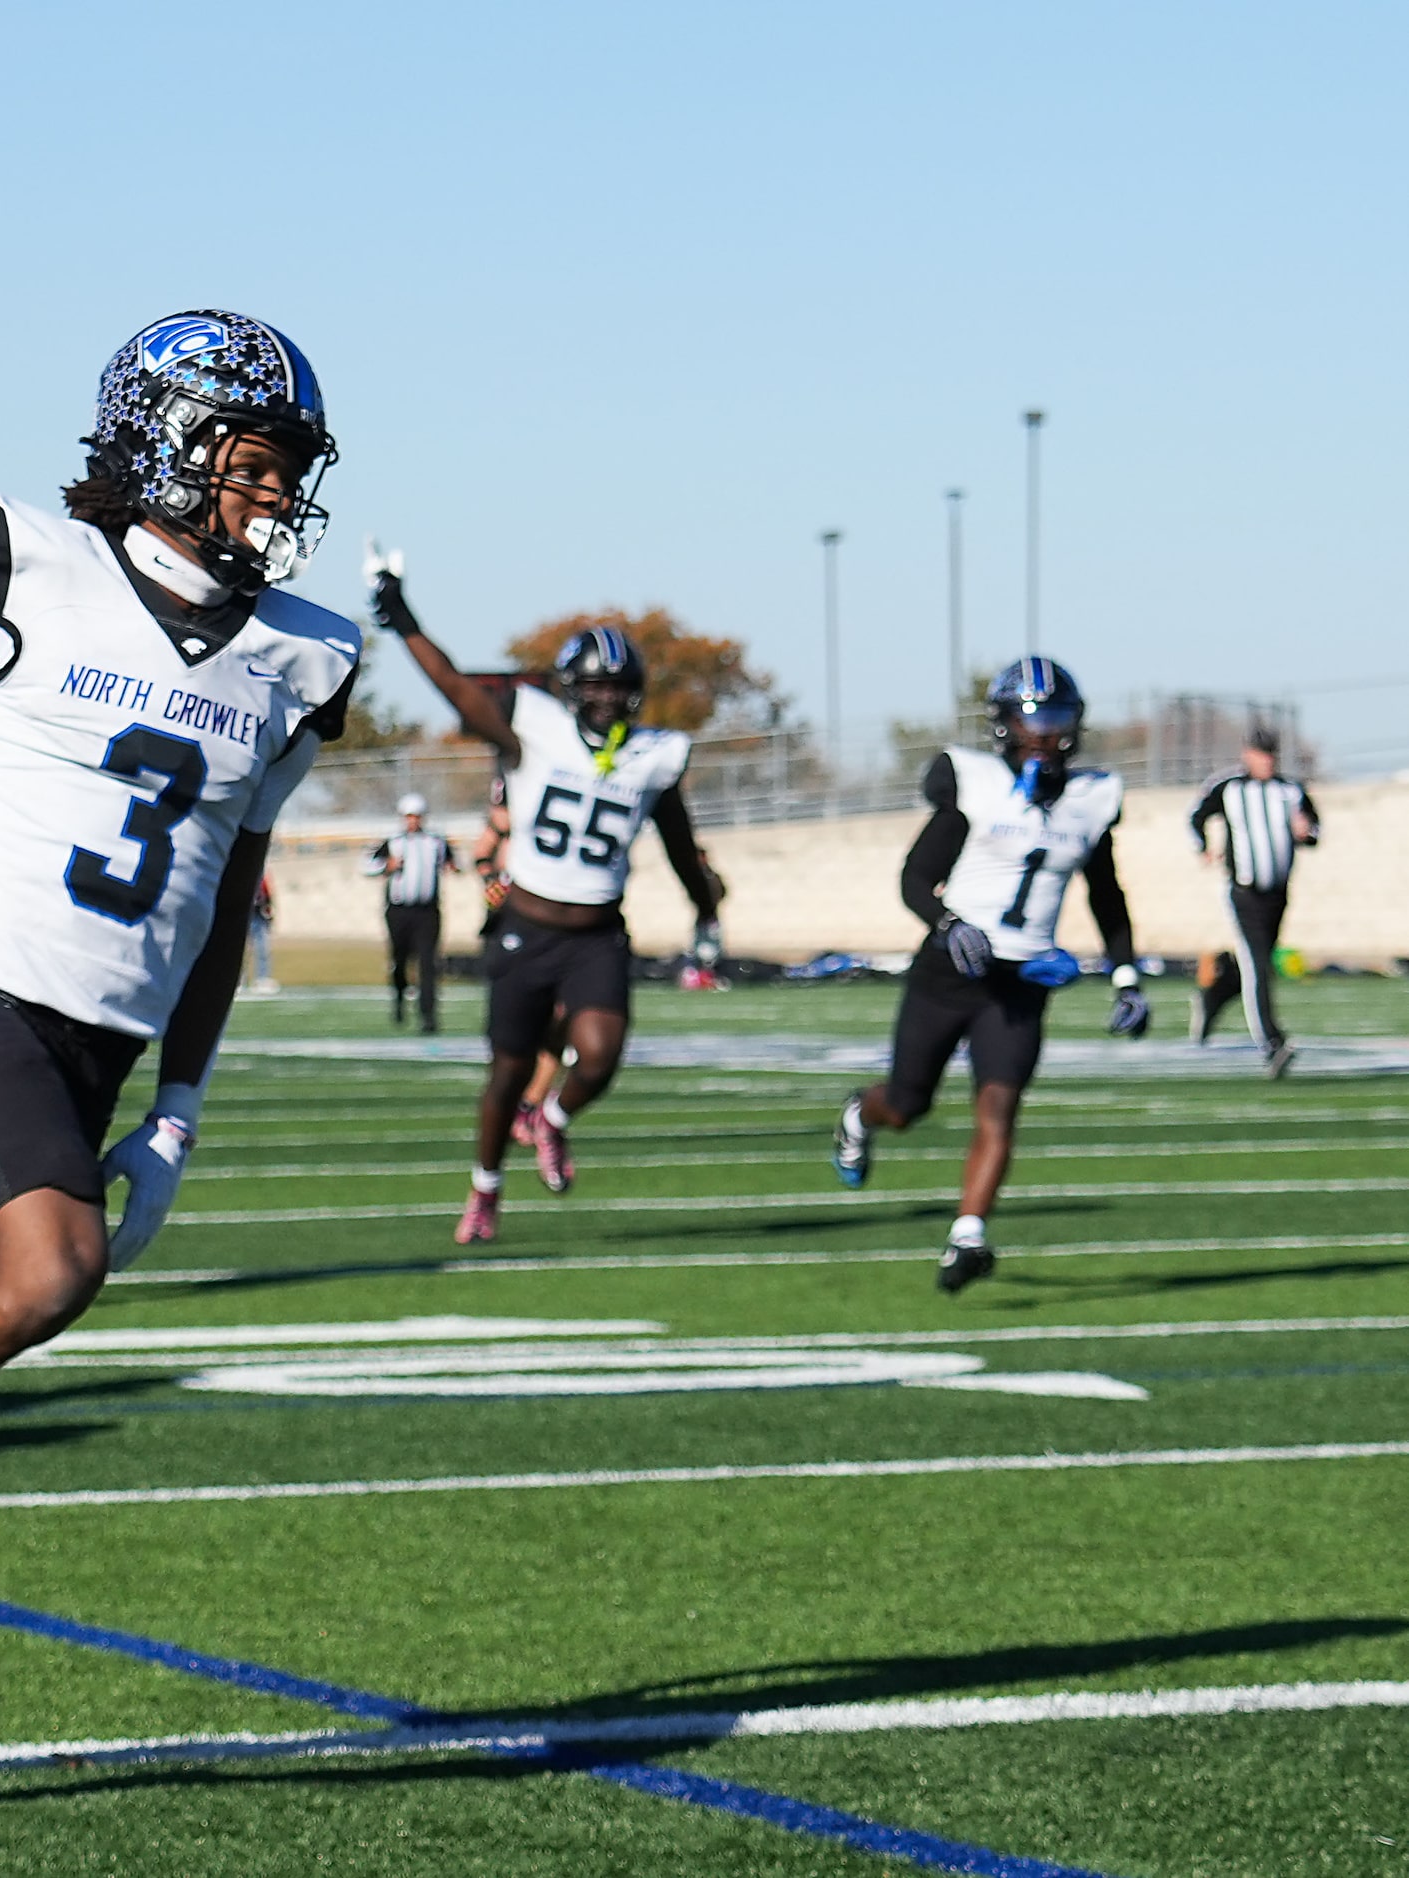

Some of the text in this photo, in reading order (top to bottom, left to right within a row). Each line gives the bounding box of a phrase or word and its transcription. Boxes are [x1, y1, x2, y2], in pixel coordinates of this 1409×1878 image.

[59, 663, 267, 752] NORTH CROWLEY
[64, 721, 208, 927] 3
[535, 785, 632, 866] 55
[1000, 848, 1047, 929] 1
